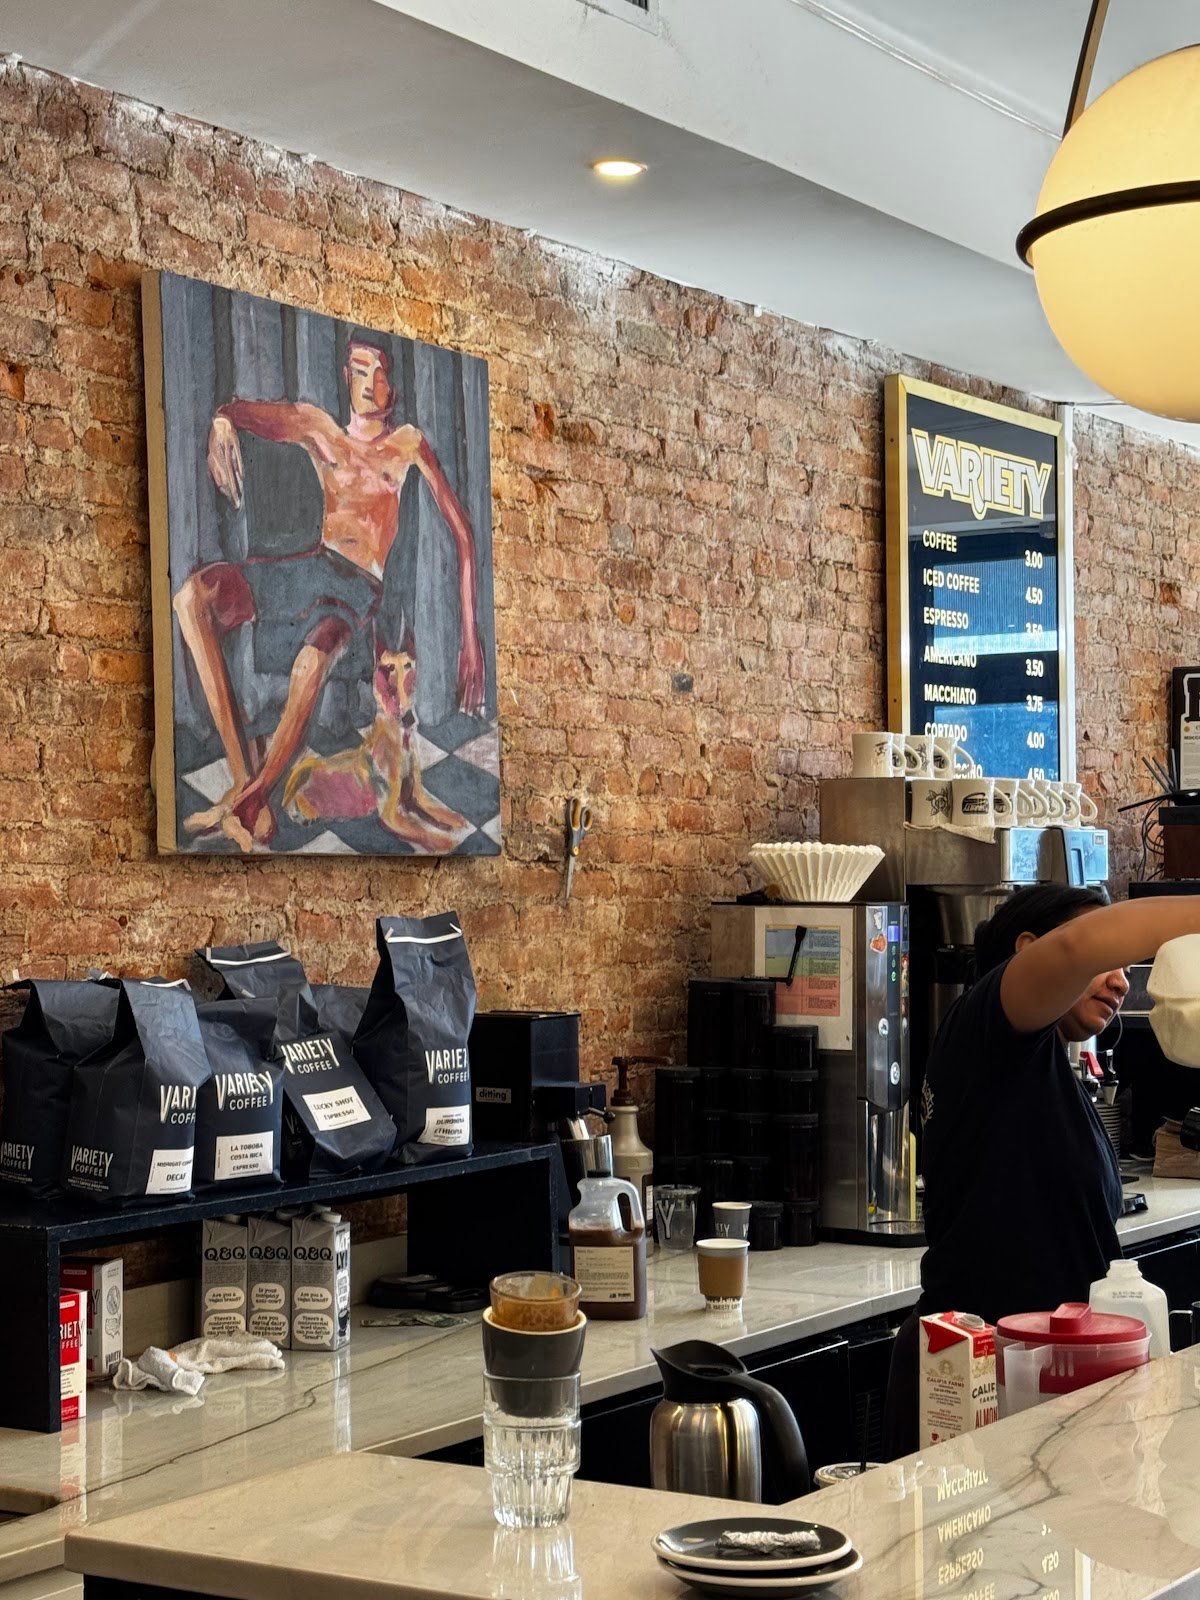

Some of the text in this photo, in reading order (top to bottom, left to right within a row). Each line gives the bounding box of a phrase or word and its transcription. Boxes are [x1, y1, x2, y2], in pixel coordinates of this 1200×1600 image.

[911, 428, 1052, 520] VARIETY
[923, 530, 957, 552] COFFEE
[1025, 550, 1043, 569] 3.00
[923, 568, 980, 593] ICED COFFEE
[1025, 587, 1043, 605] 4.50
[923, 607, 969, 629] ESPRESSO
[924, 645, 977, 668] AMERICANO
[1026, 659, 1044, 678] 3.50
[924, 684, 977, 705] MACCHIATO
[1026, 695, 1043, 713] 3.75
[925, 722, 968, 742] CORTADO
[1027, 731, 1045, 749] 4.00
[281, 1037, 340, 1075] VARIETY
[297, 1060, 332, 1074] COFFEE
[425, 1048, 469, 1084] VARIET
[438, 1071, 467, 1084] COFFEE
[215, 1071, 274, 1111] VARIETY
[479, 1089, 507, 1102] ditting
[229, 1096, 267, 1111] COFFEE
[313, 1096, 354, 1111] LUCKY SHOT
[3, 1160, 27, 1170] COFFEE
[70, 1145, 114, 1178] VARIETY
[230, 1152, 249, 1161] COSTA
[74, 1164, 103, 1178] COFFEE
[204, 1246, 247, 1262] Q&Q
[249, 1246, 291, 1261] Q&Q
[293, 1246, 334, 1261] Q&Q
[59, 1318, 86, 1347] RIETY
[61, 1338, 78, 1349] FFEE
